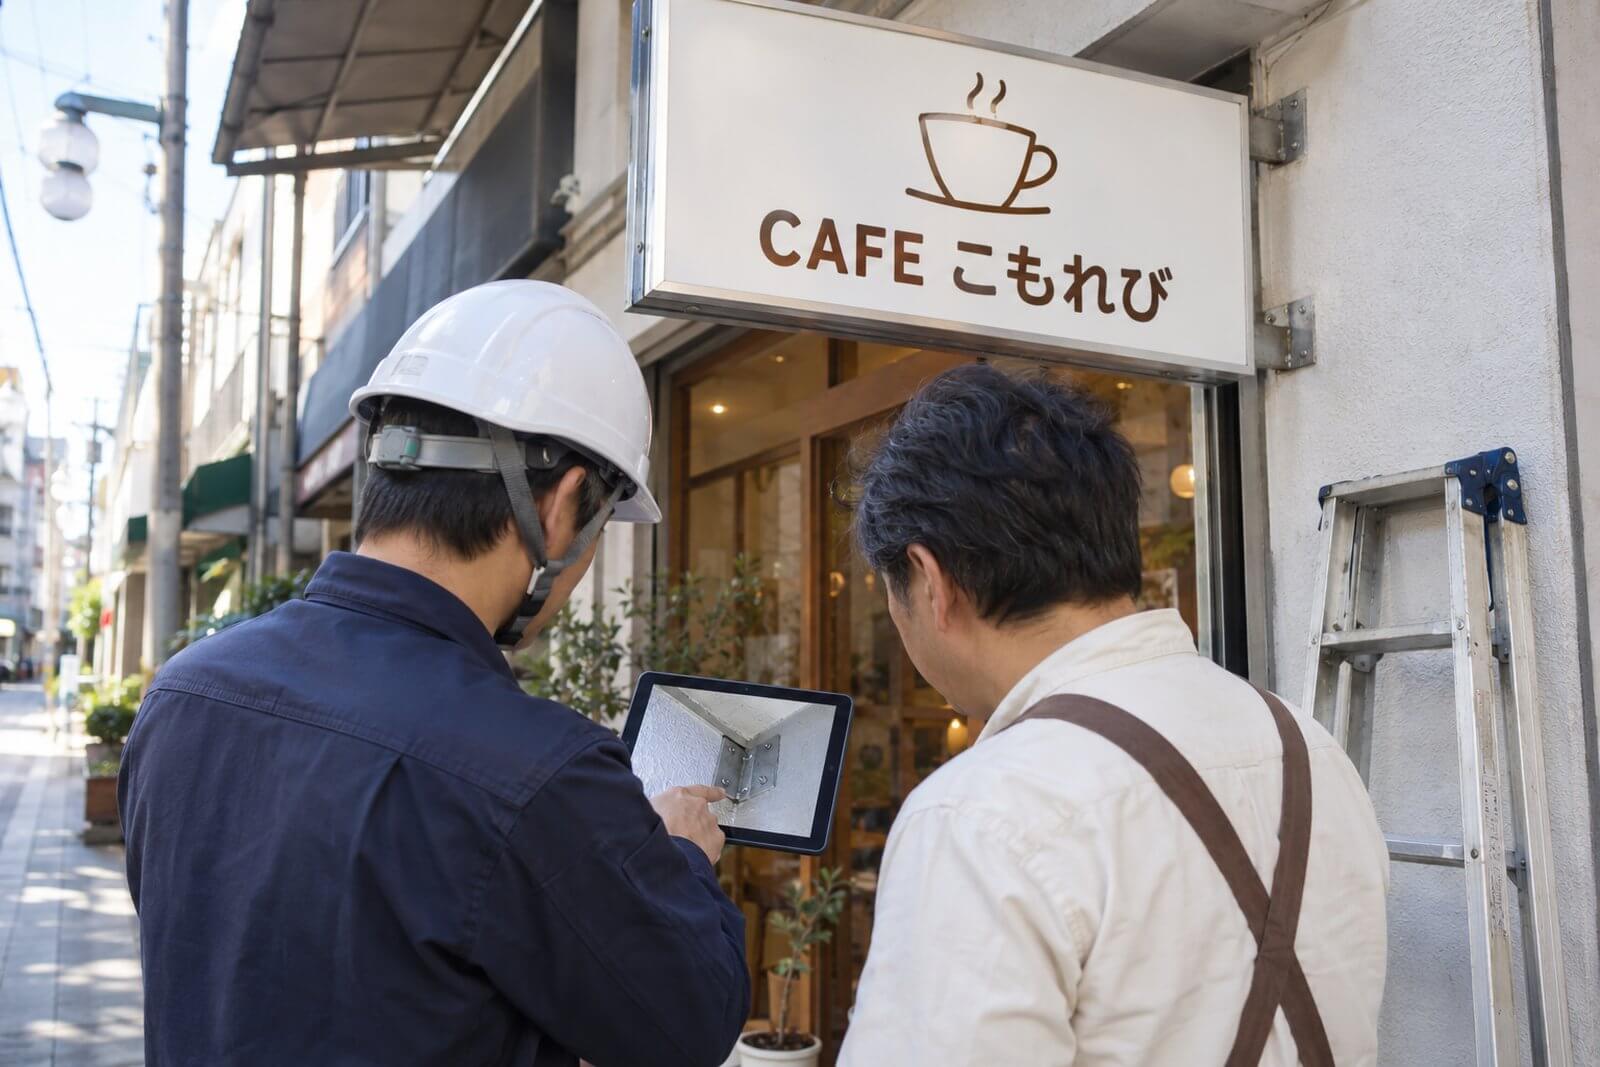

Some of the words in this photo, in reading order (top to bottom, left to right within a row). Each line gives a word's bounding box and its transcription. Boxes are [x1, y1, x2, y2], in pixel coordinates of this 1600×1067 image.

[760, 209, 924, 286] CAFE
[953, 240, 1174, 324] こもれび
